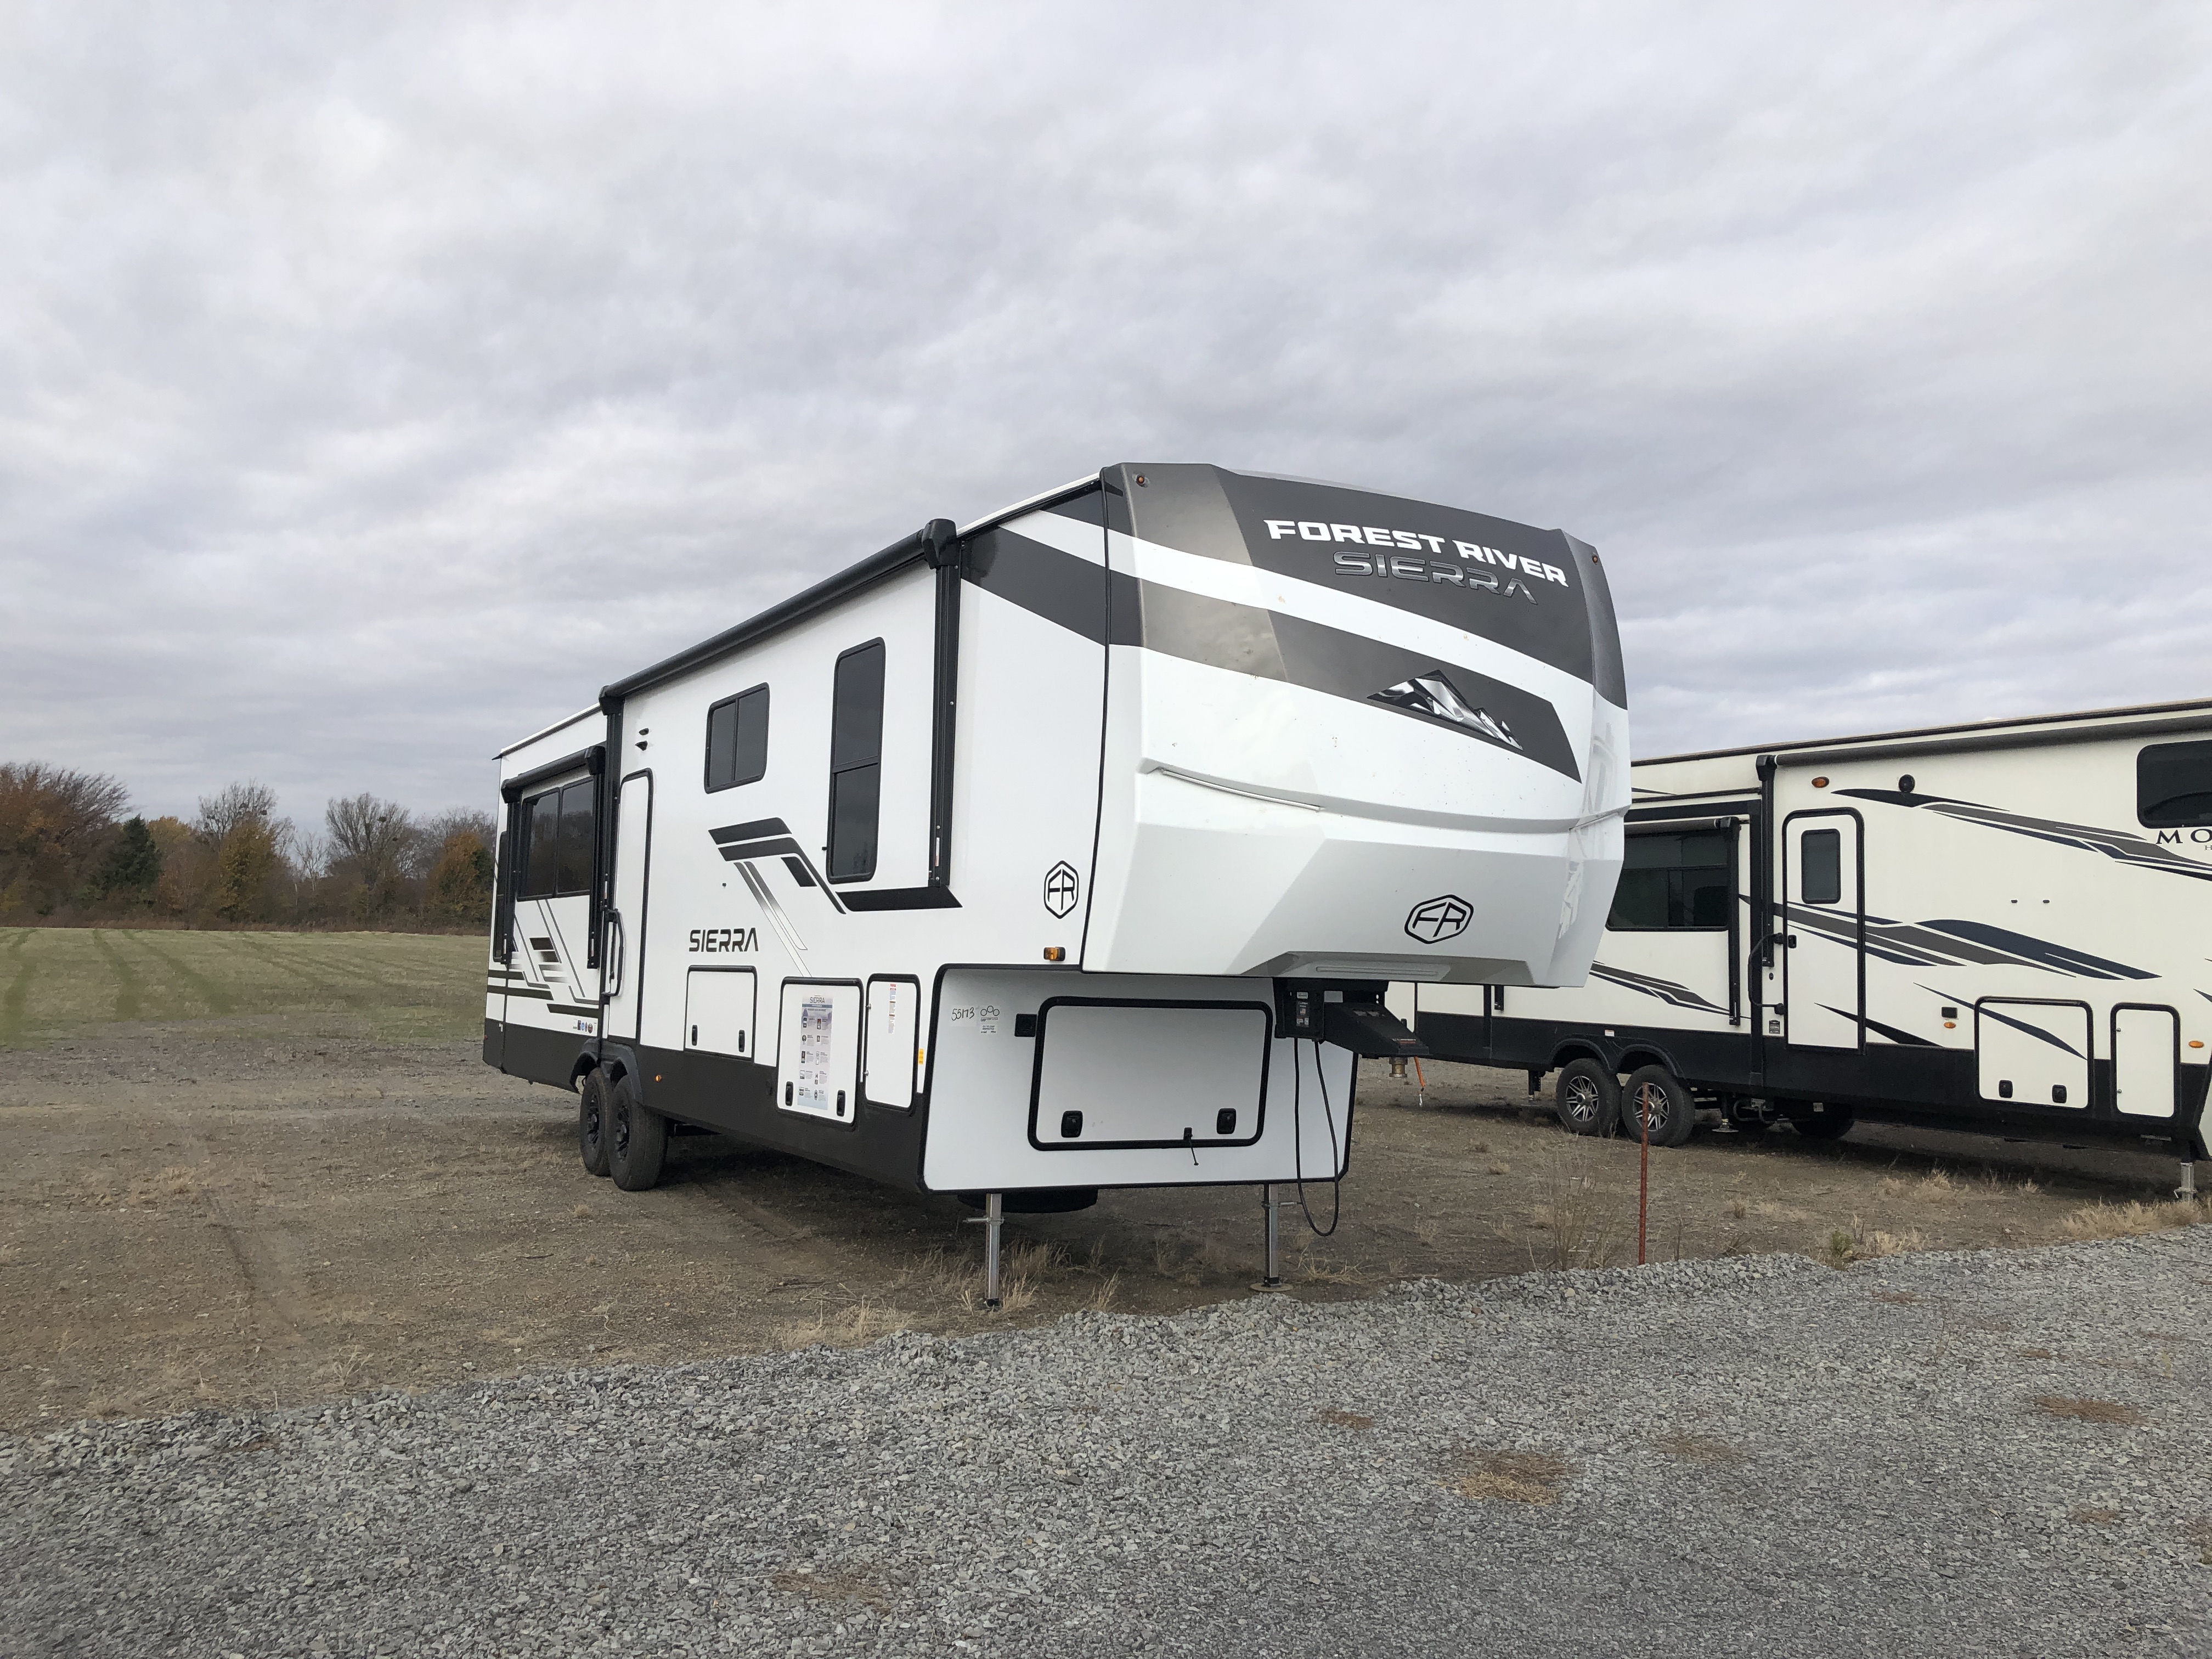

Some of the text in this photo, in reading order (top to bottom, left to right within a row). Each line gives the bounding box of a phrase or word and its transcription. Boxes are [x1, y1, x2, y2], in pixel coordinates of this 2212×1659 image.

[1263, 519, 1569, 588] FOREST RIVER
[1333, 550, 1538, 605] SIERRA
[2155, 828, 2212, 844] MO
[689, 927, 759, 952] SIERRA
